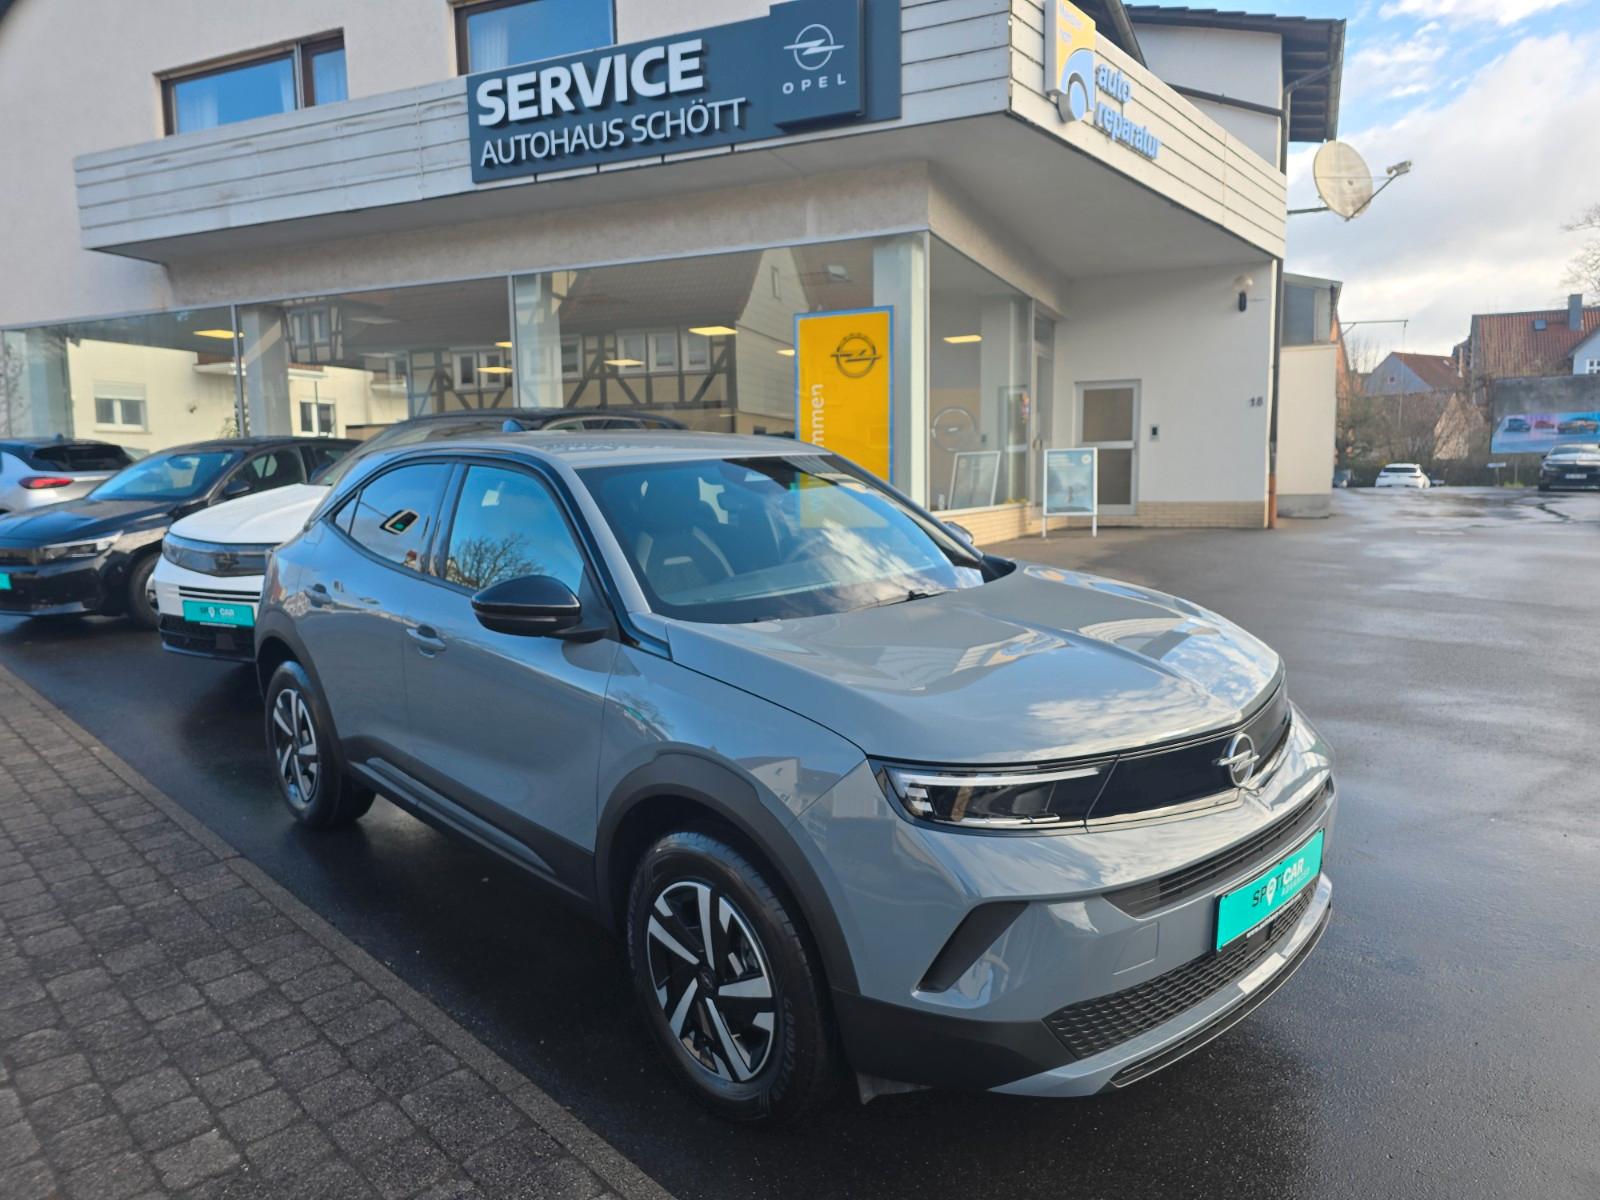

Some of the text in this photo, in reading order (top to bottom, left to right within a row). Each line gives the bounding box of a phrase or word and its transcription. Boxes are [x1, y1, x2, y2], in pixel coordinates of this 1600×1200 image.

[477, 38, 703, 126] SERVICE
[782, 73, 847, 95] OPEL
[1097, 63, 1132, 104] auto
[480, 97, 746, 167] AUTOHAUS SCHÖTT
[1095, 102, 1161, 160] reparatur
